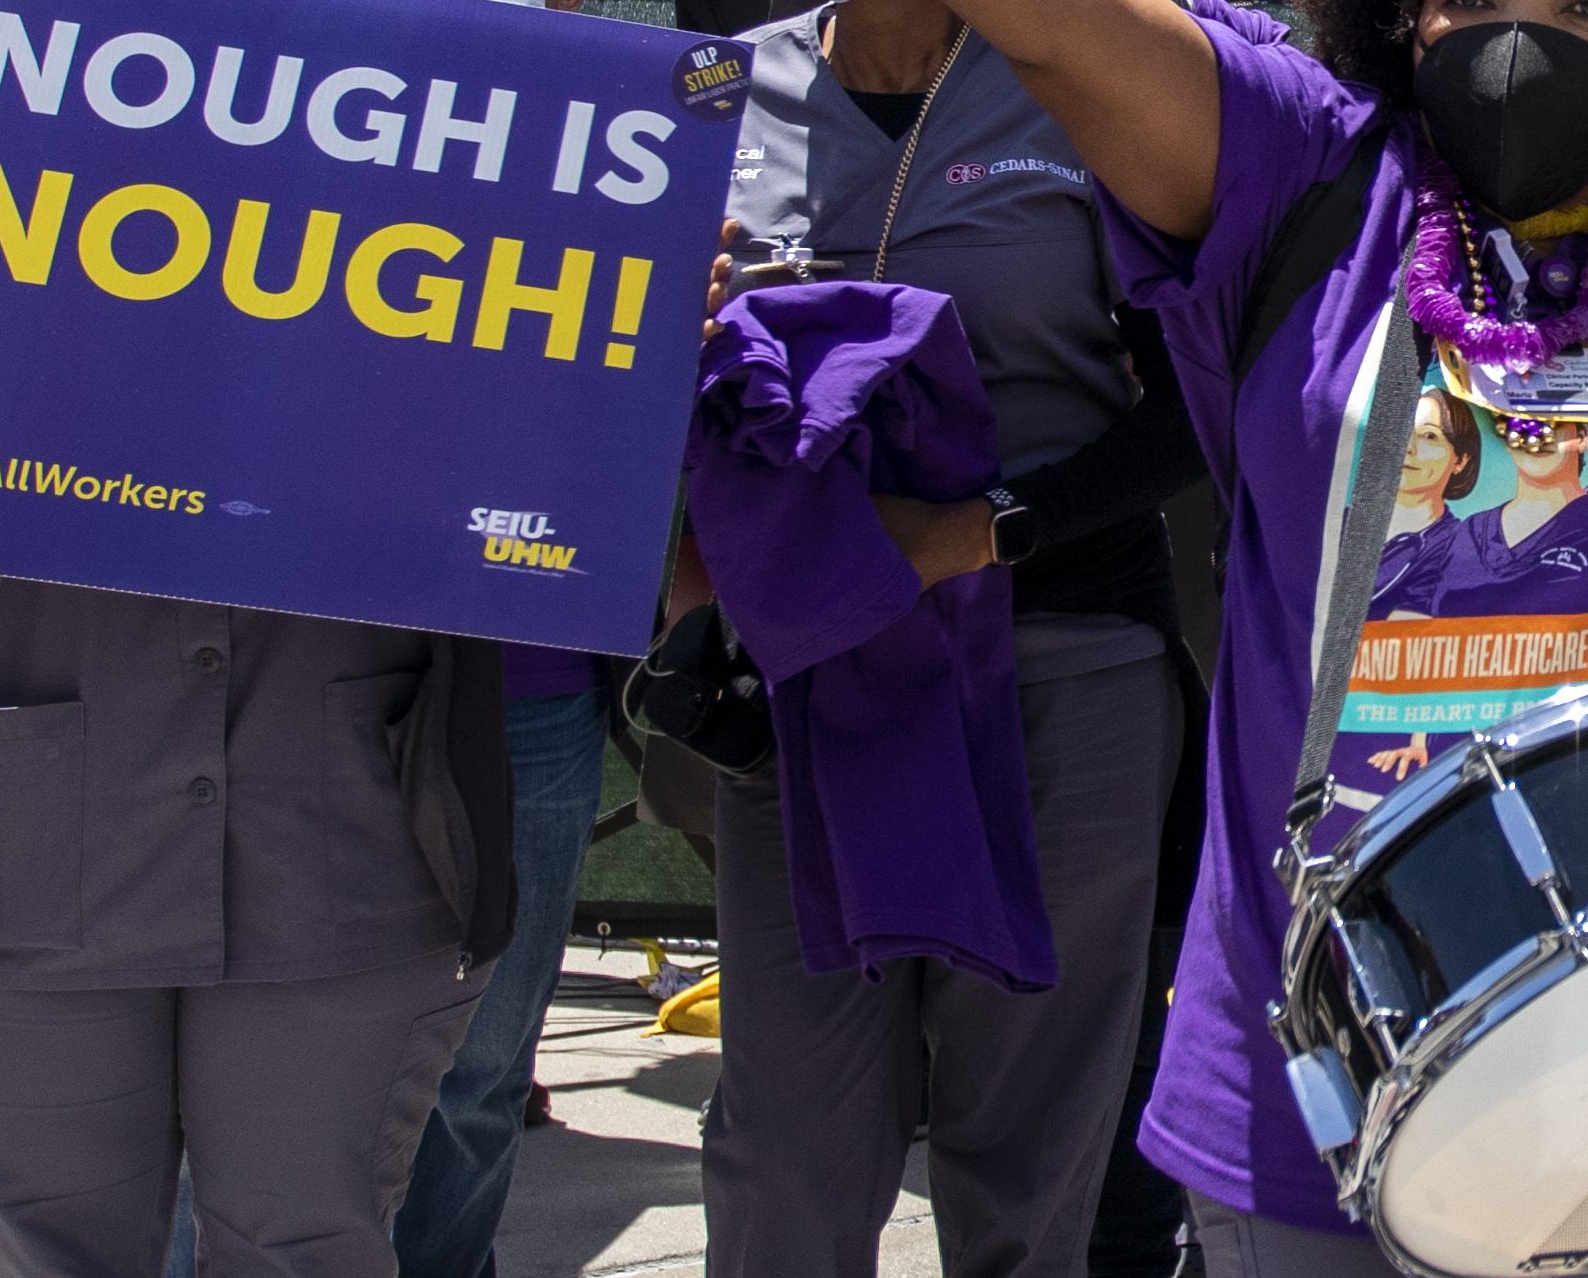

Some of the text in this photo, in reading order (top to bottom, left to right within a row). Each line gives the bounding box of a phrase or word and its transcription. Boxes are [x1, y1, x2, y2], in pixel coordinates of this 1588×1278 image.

[691, 46, 718, 69] ULP
[684, 59, 743, 92] STRIKE!
[552, 100, 677, 205] IS
[989, 158, 1086, 184] CEDARS-SINAI
[467, 507, 556, 539] SEIU-
[483, 536, 577, 571] UHW
[1405, 635, 1461, 681] WITH
[1356, 704, 1398, 722] THE
[1403, 702, 1476, 723] HEART
[1483, 701, 1506, 719] OF
